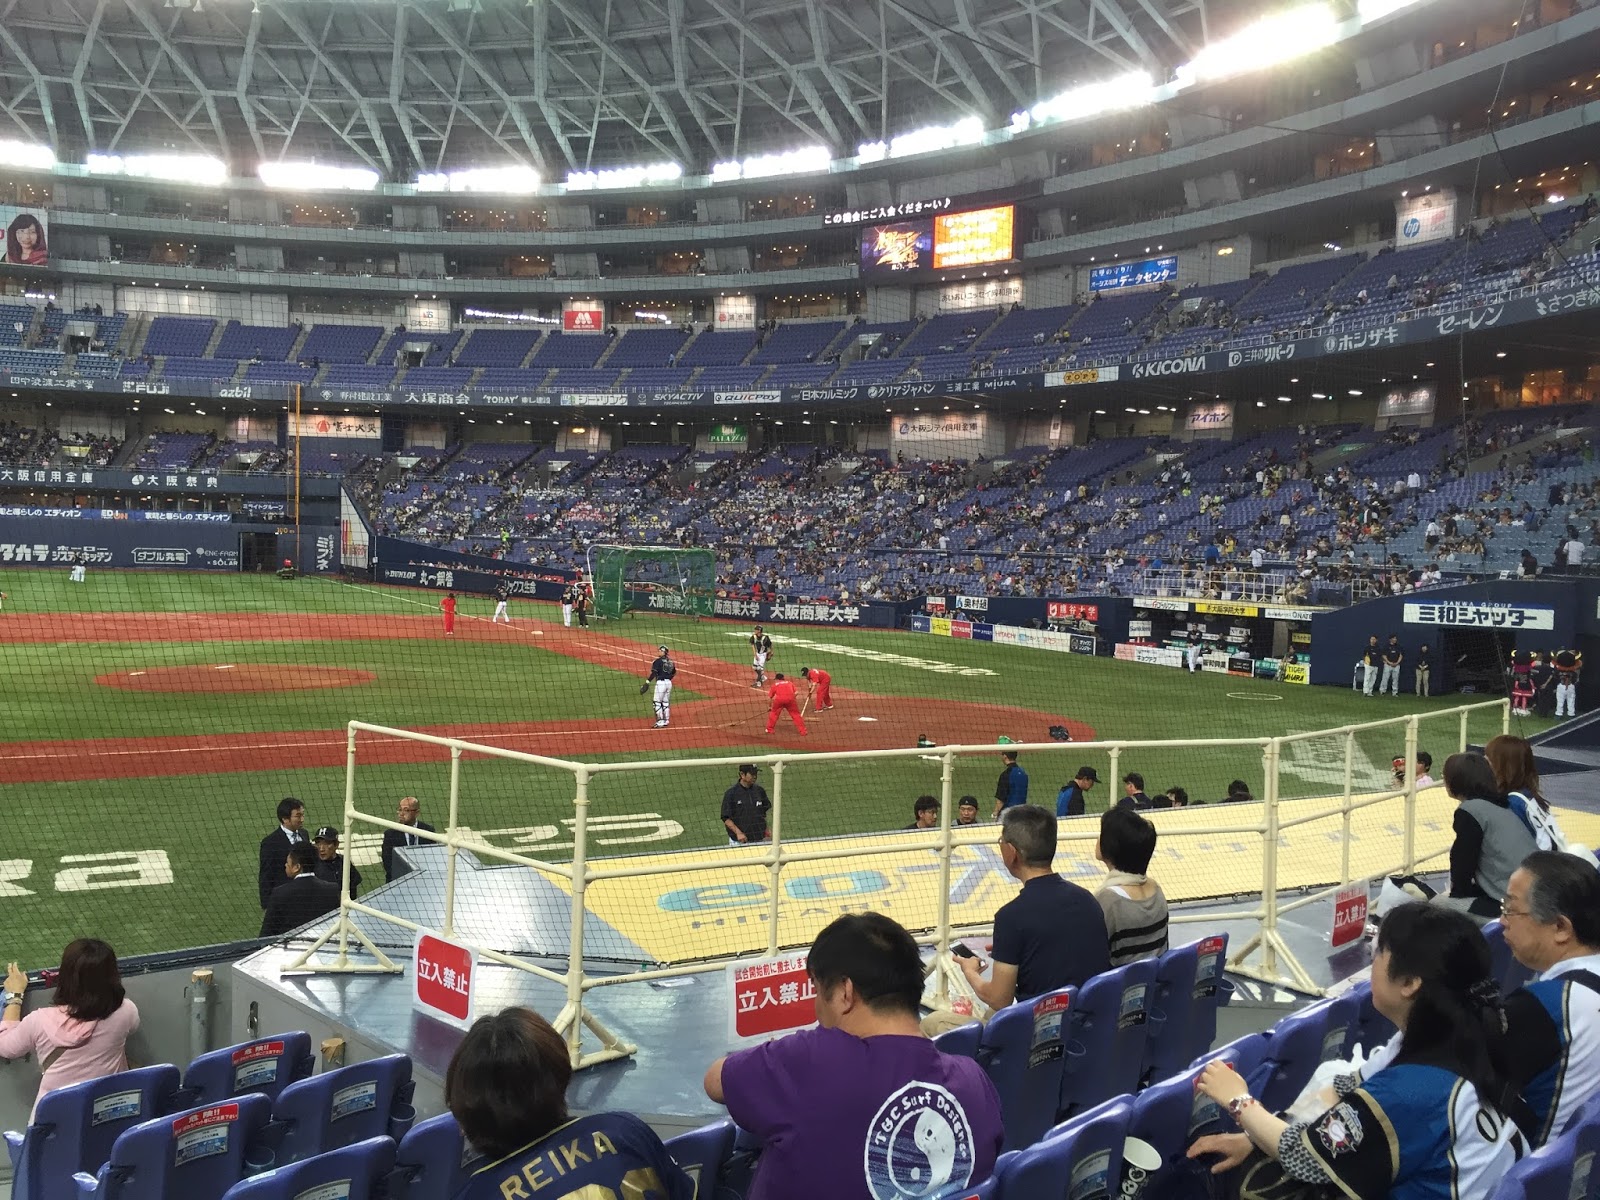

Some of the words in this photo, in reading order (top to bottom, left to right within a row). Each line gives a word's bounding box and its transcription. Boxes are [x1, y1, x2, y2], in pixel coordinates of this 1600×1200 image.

[1119, 268, 1177, 287] データセンター
[1437, 306, 1504, 335] セーレン
[1338, 327, 1399, 351] ホシザキ
[1245, 344, 1296, 362] 三井のリパーク
[1144, 356, 1206, 377] KICONA
[135, 384, 170, 395] FUJI
[877, 383, 936, 398] クリアジャパン
[985, 379, 1017, 390] MIURA
[219, 387, 252, 398] azbil
[404, 392, 471, 405] 大塚商会
[652, 393, 704, 401] SKYACTIV
[801, 387, 858, 401] 日本カルミック
[1190, 412, 1231, 424] アイホン
[910, 422, 977, 433] 大阪シティ信用金庫
[1, 469, 94, 485] 大阪信用金庫
[44, 509, 81, 517] エディオン
[195, 513, 230, 521] エディオン
[137, 551, 185, 562] ダブル発電
[389, 570, 417, 579] DUNLOP
[769, 602, 860, 624] 大阪商業大学
[1419, 605, 1538, 627] 三和シャッター
[1334, 902, 1366, 928] 立入禁止
[418, 957, 468, 996] 立入禁止
[738, 978, 818, 1013] 立入禁止
[901, 1091, 932, 1110] Surf
[936, 1095, 967, 1158] Designs
[499, 1130, 619, 1200] REIKA
